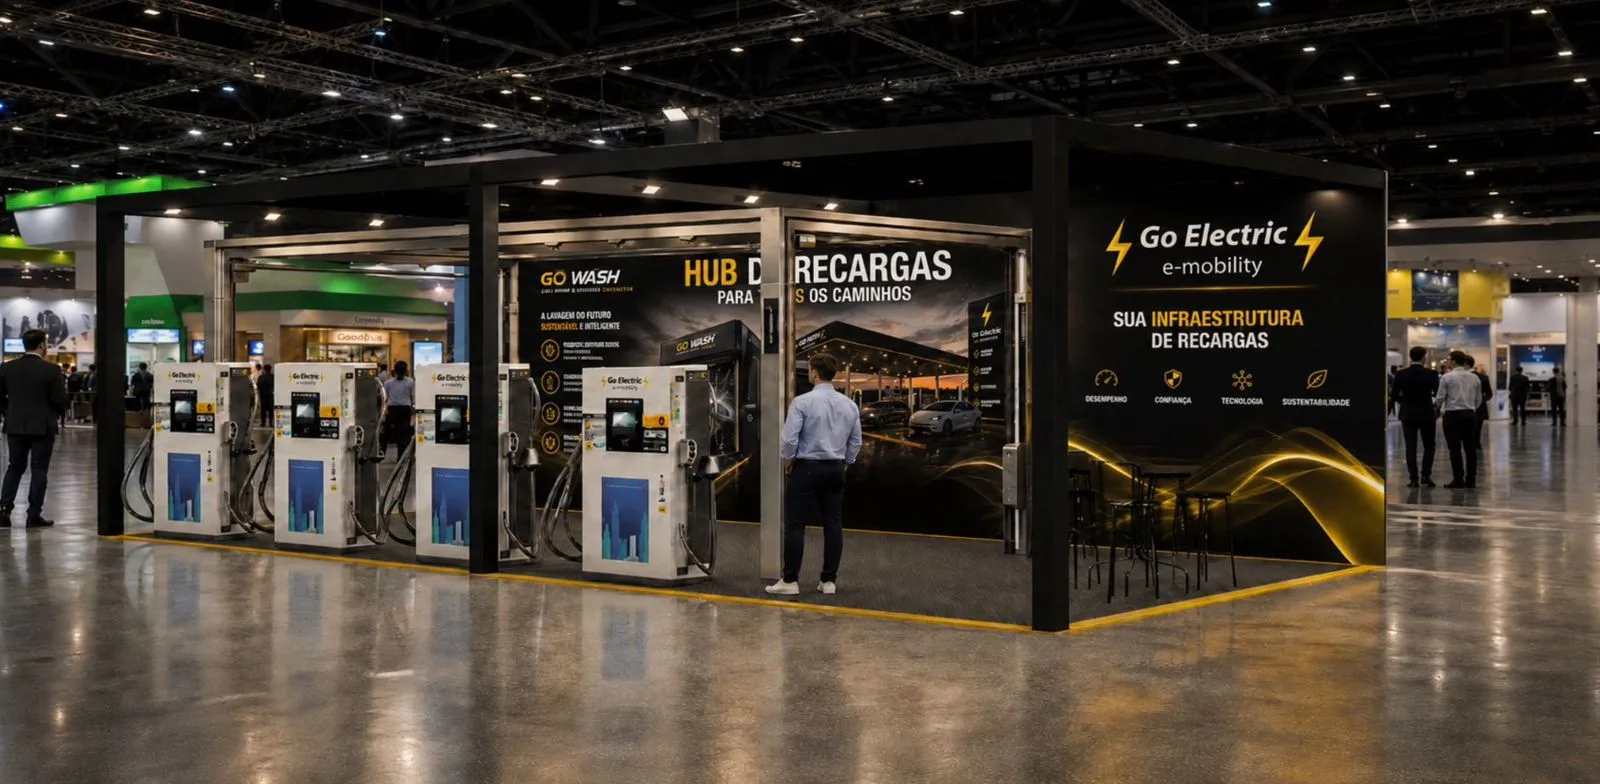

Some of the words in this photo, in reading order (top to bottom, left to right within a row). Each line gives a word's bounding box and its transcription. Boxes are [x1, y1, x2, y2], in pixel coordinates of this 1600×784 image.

[1140, 225, 1177, 248] Go
[1184, 220, 1288, 247] Electric
[684, 258, 738, 287] HUB
[748, 258, 762, 286] D
[795, 250, 952, 284] RECARGAS
[1162, 256, 1263, 278] e-mobility
[541, 271, 566, 286] GO
[571, 269, 620, 285] WASH
[717, 289, 754, 305] PARA
[809, 287, 827, 303] OS
[832, 285, 912, 303] CAMINHOS
[541, 312, 546, 320] A
[546, 311, 575, 320] LAVAGEM
[576, 311, 586, 319] DO
[586, 310, 612, 320] FUTURO
[1113, 311, 1147, 328] SUA
[1151, 309, 1304, 328] INFRAESTRUTURA
[579, 322, 584, 330] E
[585, 321, 620, 331] INTELIGENTE
[676, 341, 689, 352] GO
[690, 332, 716, 348] WASH
[1151, 332, 1173, 349] DE
[1178, 331, 1269, 349] RECARGAS
[607, 376, 616, 384] Go
[618, 376, 642, 384] Electric
[1085, 395, 1128, 404] DESEMPENHO
[1154, 396, 1192, 405] CONFIANÇA
[1221, 397, 1264, 405] TECNOLOGIA
[1282, 398, 1350, 407] SUSTENTABILIDADE
